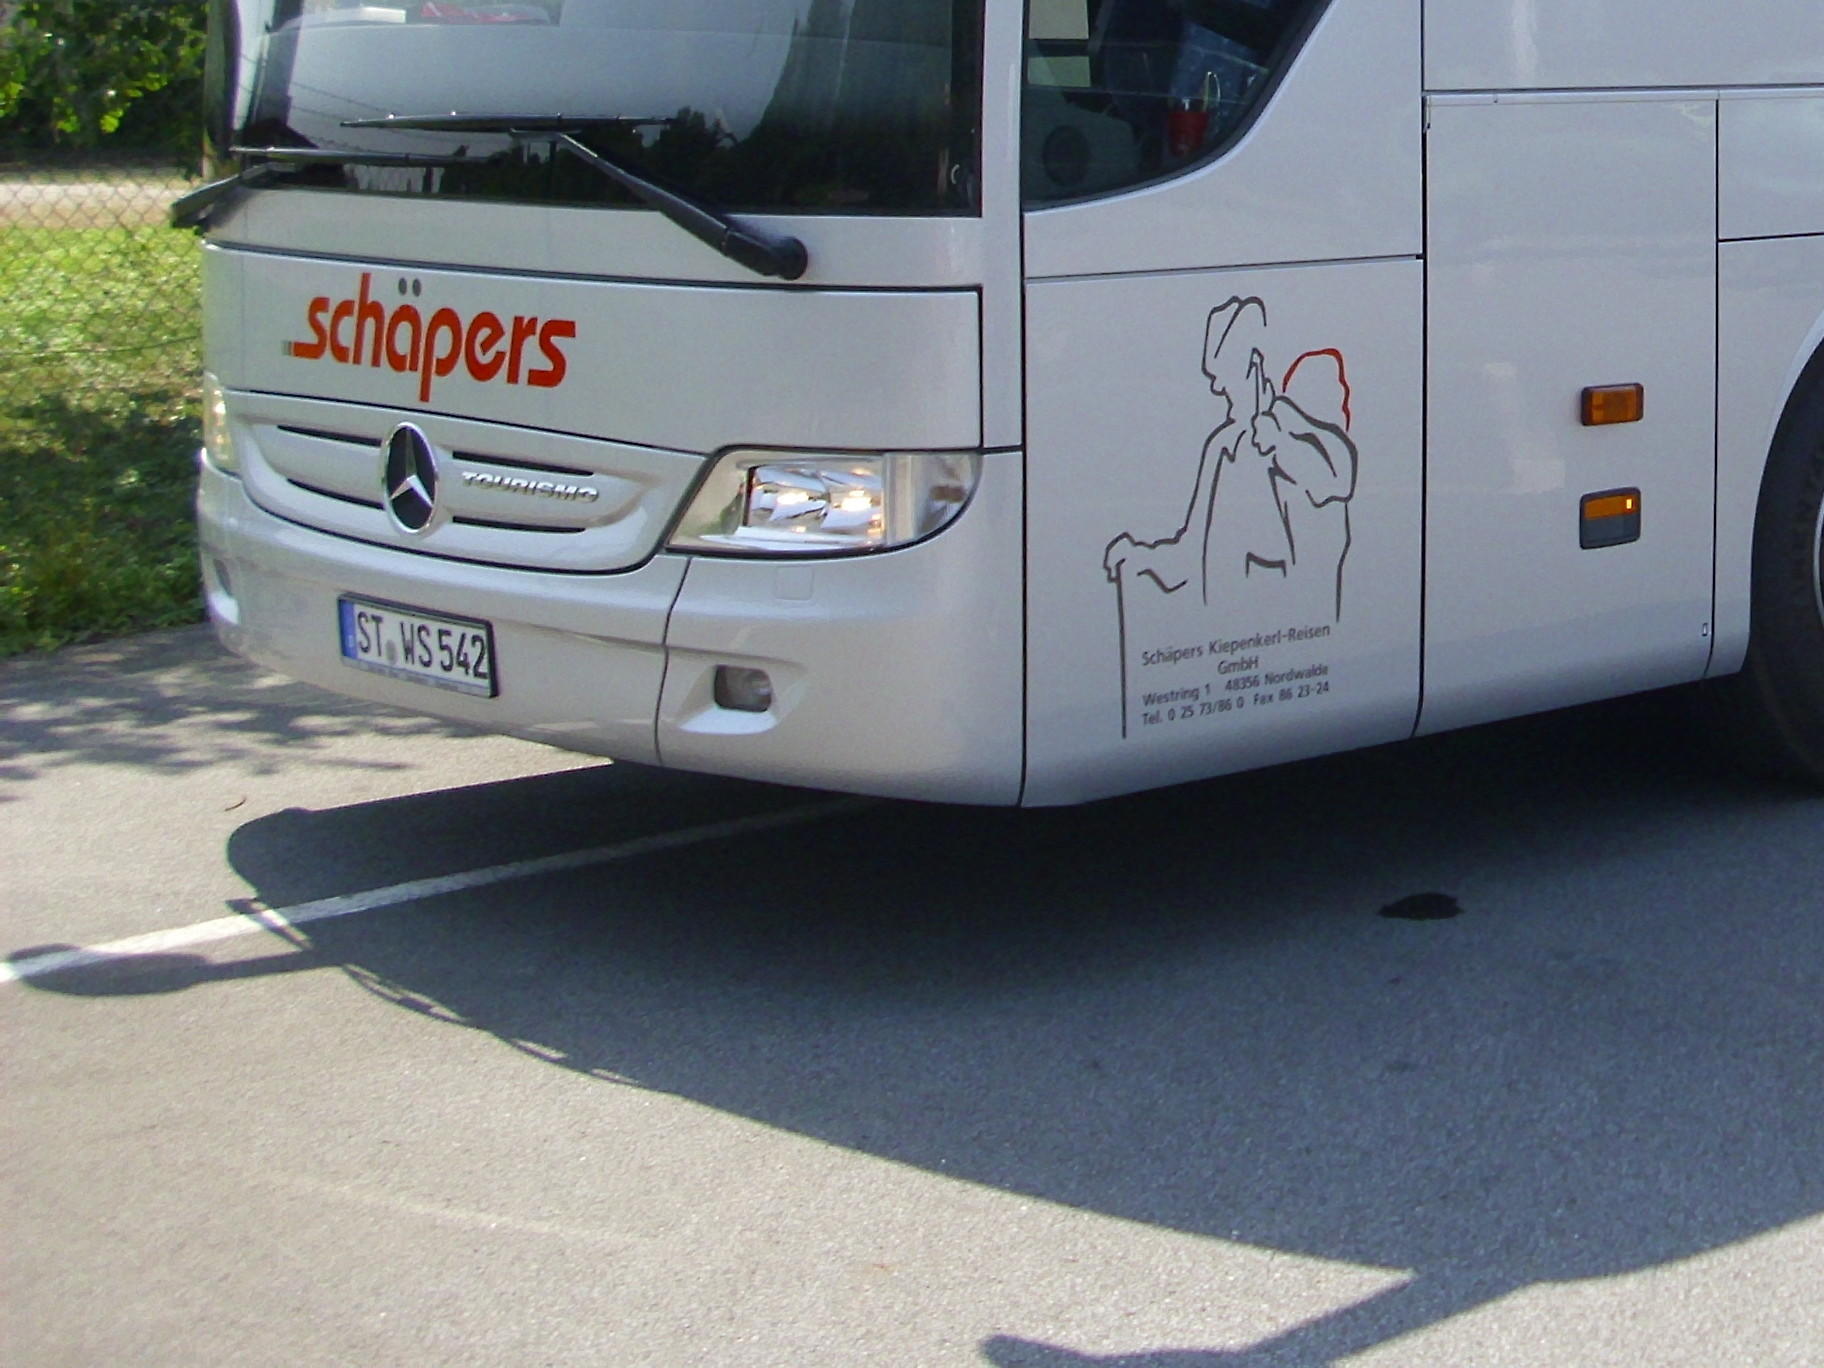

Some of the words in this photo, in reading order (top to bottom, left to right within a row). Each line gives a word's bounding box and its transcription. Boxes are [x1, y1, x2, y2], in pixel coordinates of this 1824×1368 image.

[283, 272, 576, 402] schäpers
[462, 471, 599, 503] TOURISMO
[357, 611, 384, 656] ST
[1142, 645, 1203, 666] Schäpers
[1217, 656, 1259, 675] GmbH
[1142, 687, 1200, 707] Westring
[1264, 664, 1329, 686] Nordwalde
